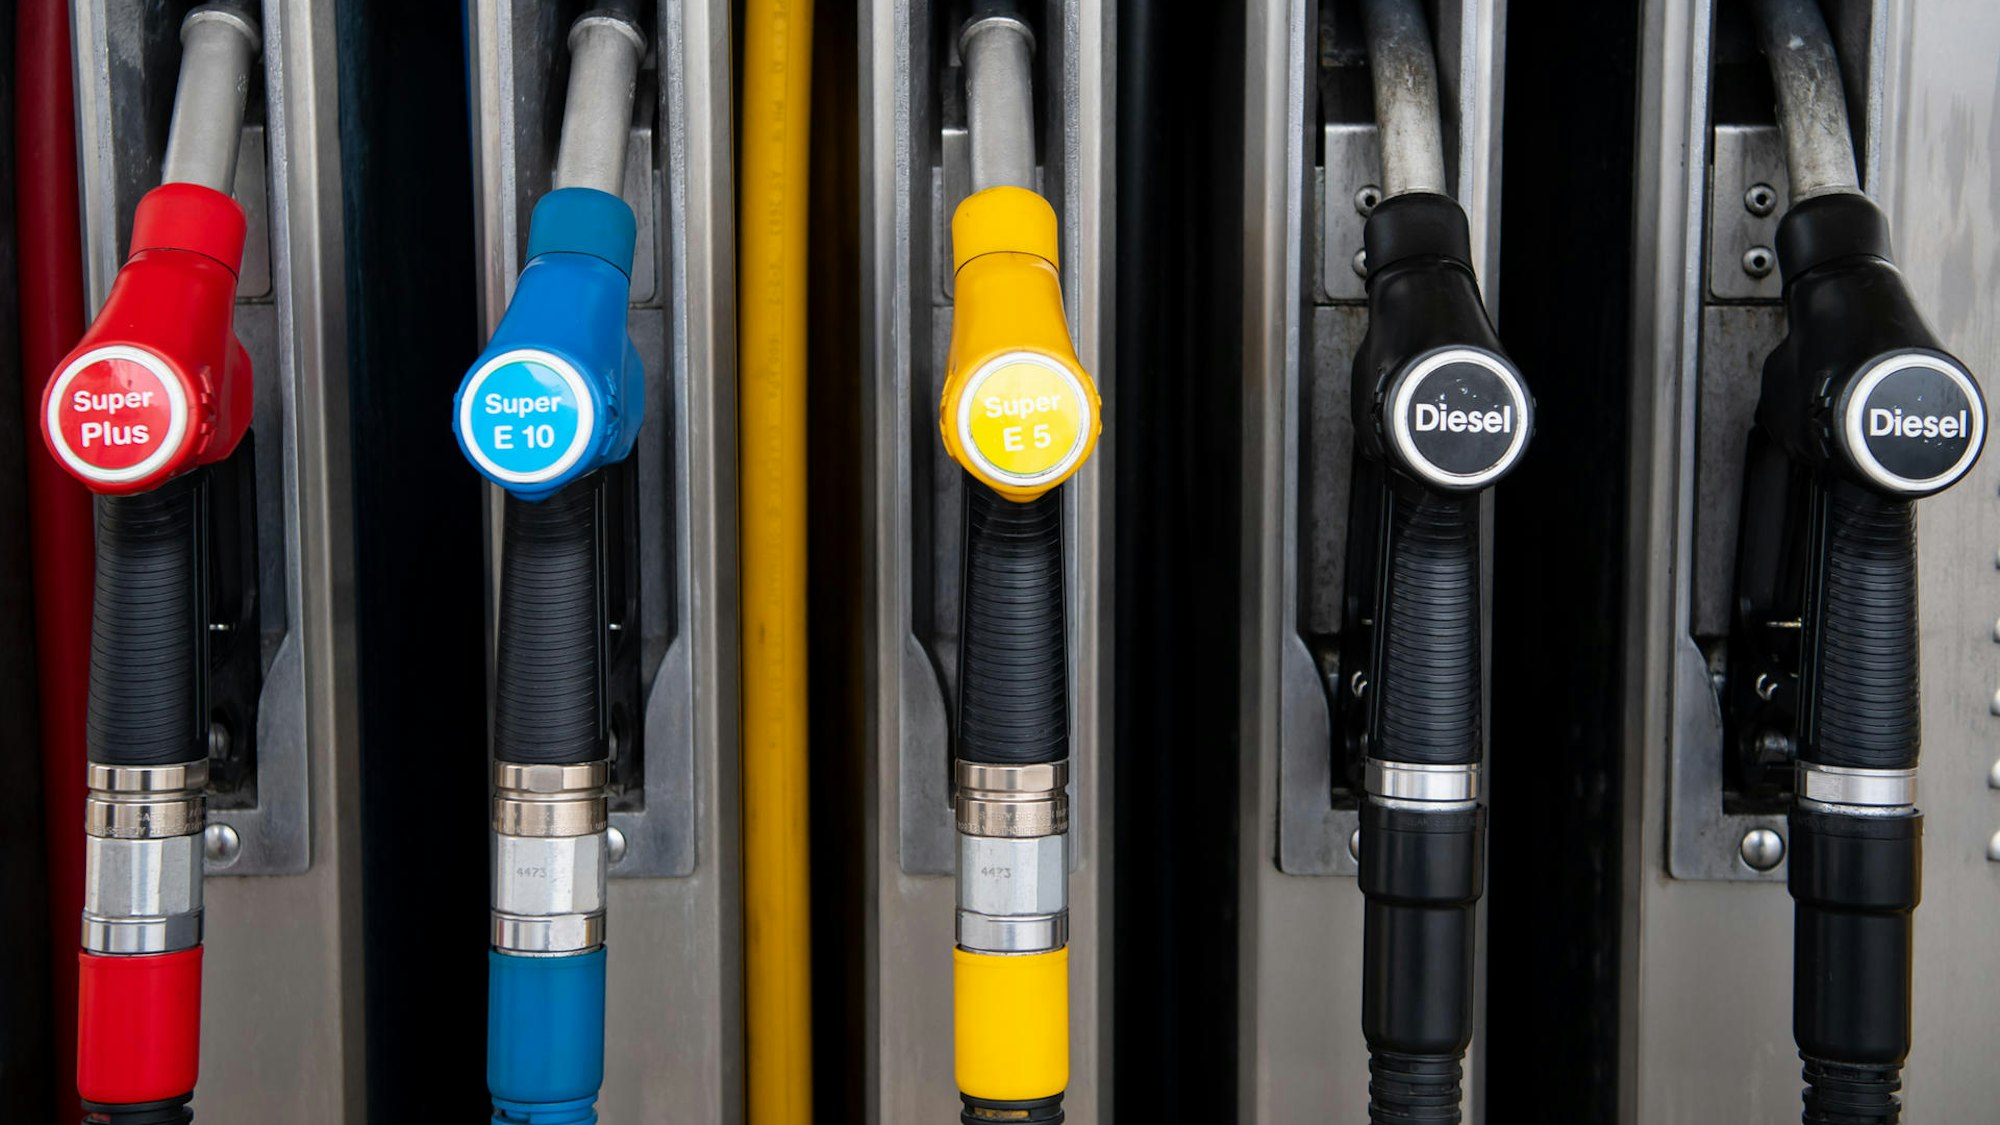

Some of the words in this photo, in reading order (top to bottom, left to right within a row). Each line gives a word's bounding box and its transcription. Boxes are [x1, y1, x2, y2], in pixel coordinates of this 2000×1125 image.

[74, 389, 153, 414] Super
[486, 392, 561, 417] Super
[985, 392, 1061, 419] Super
[1416, 403, 1511, 433] Diesel
[1870, 408, 1966, 438] Diesel
[82, 421, 150, 447] Plus
[495, 426, 514, 449] E
[523, 425, 555, 449] 10
[1004, 427, 1024, 451] E
[1034, 424, 1052, 448] 5
[516, 867, 548, 878] 4473
